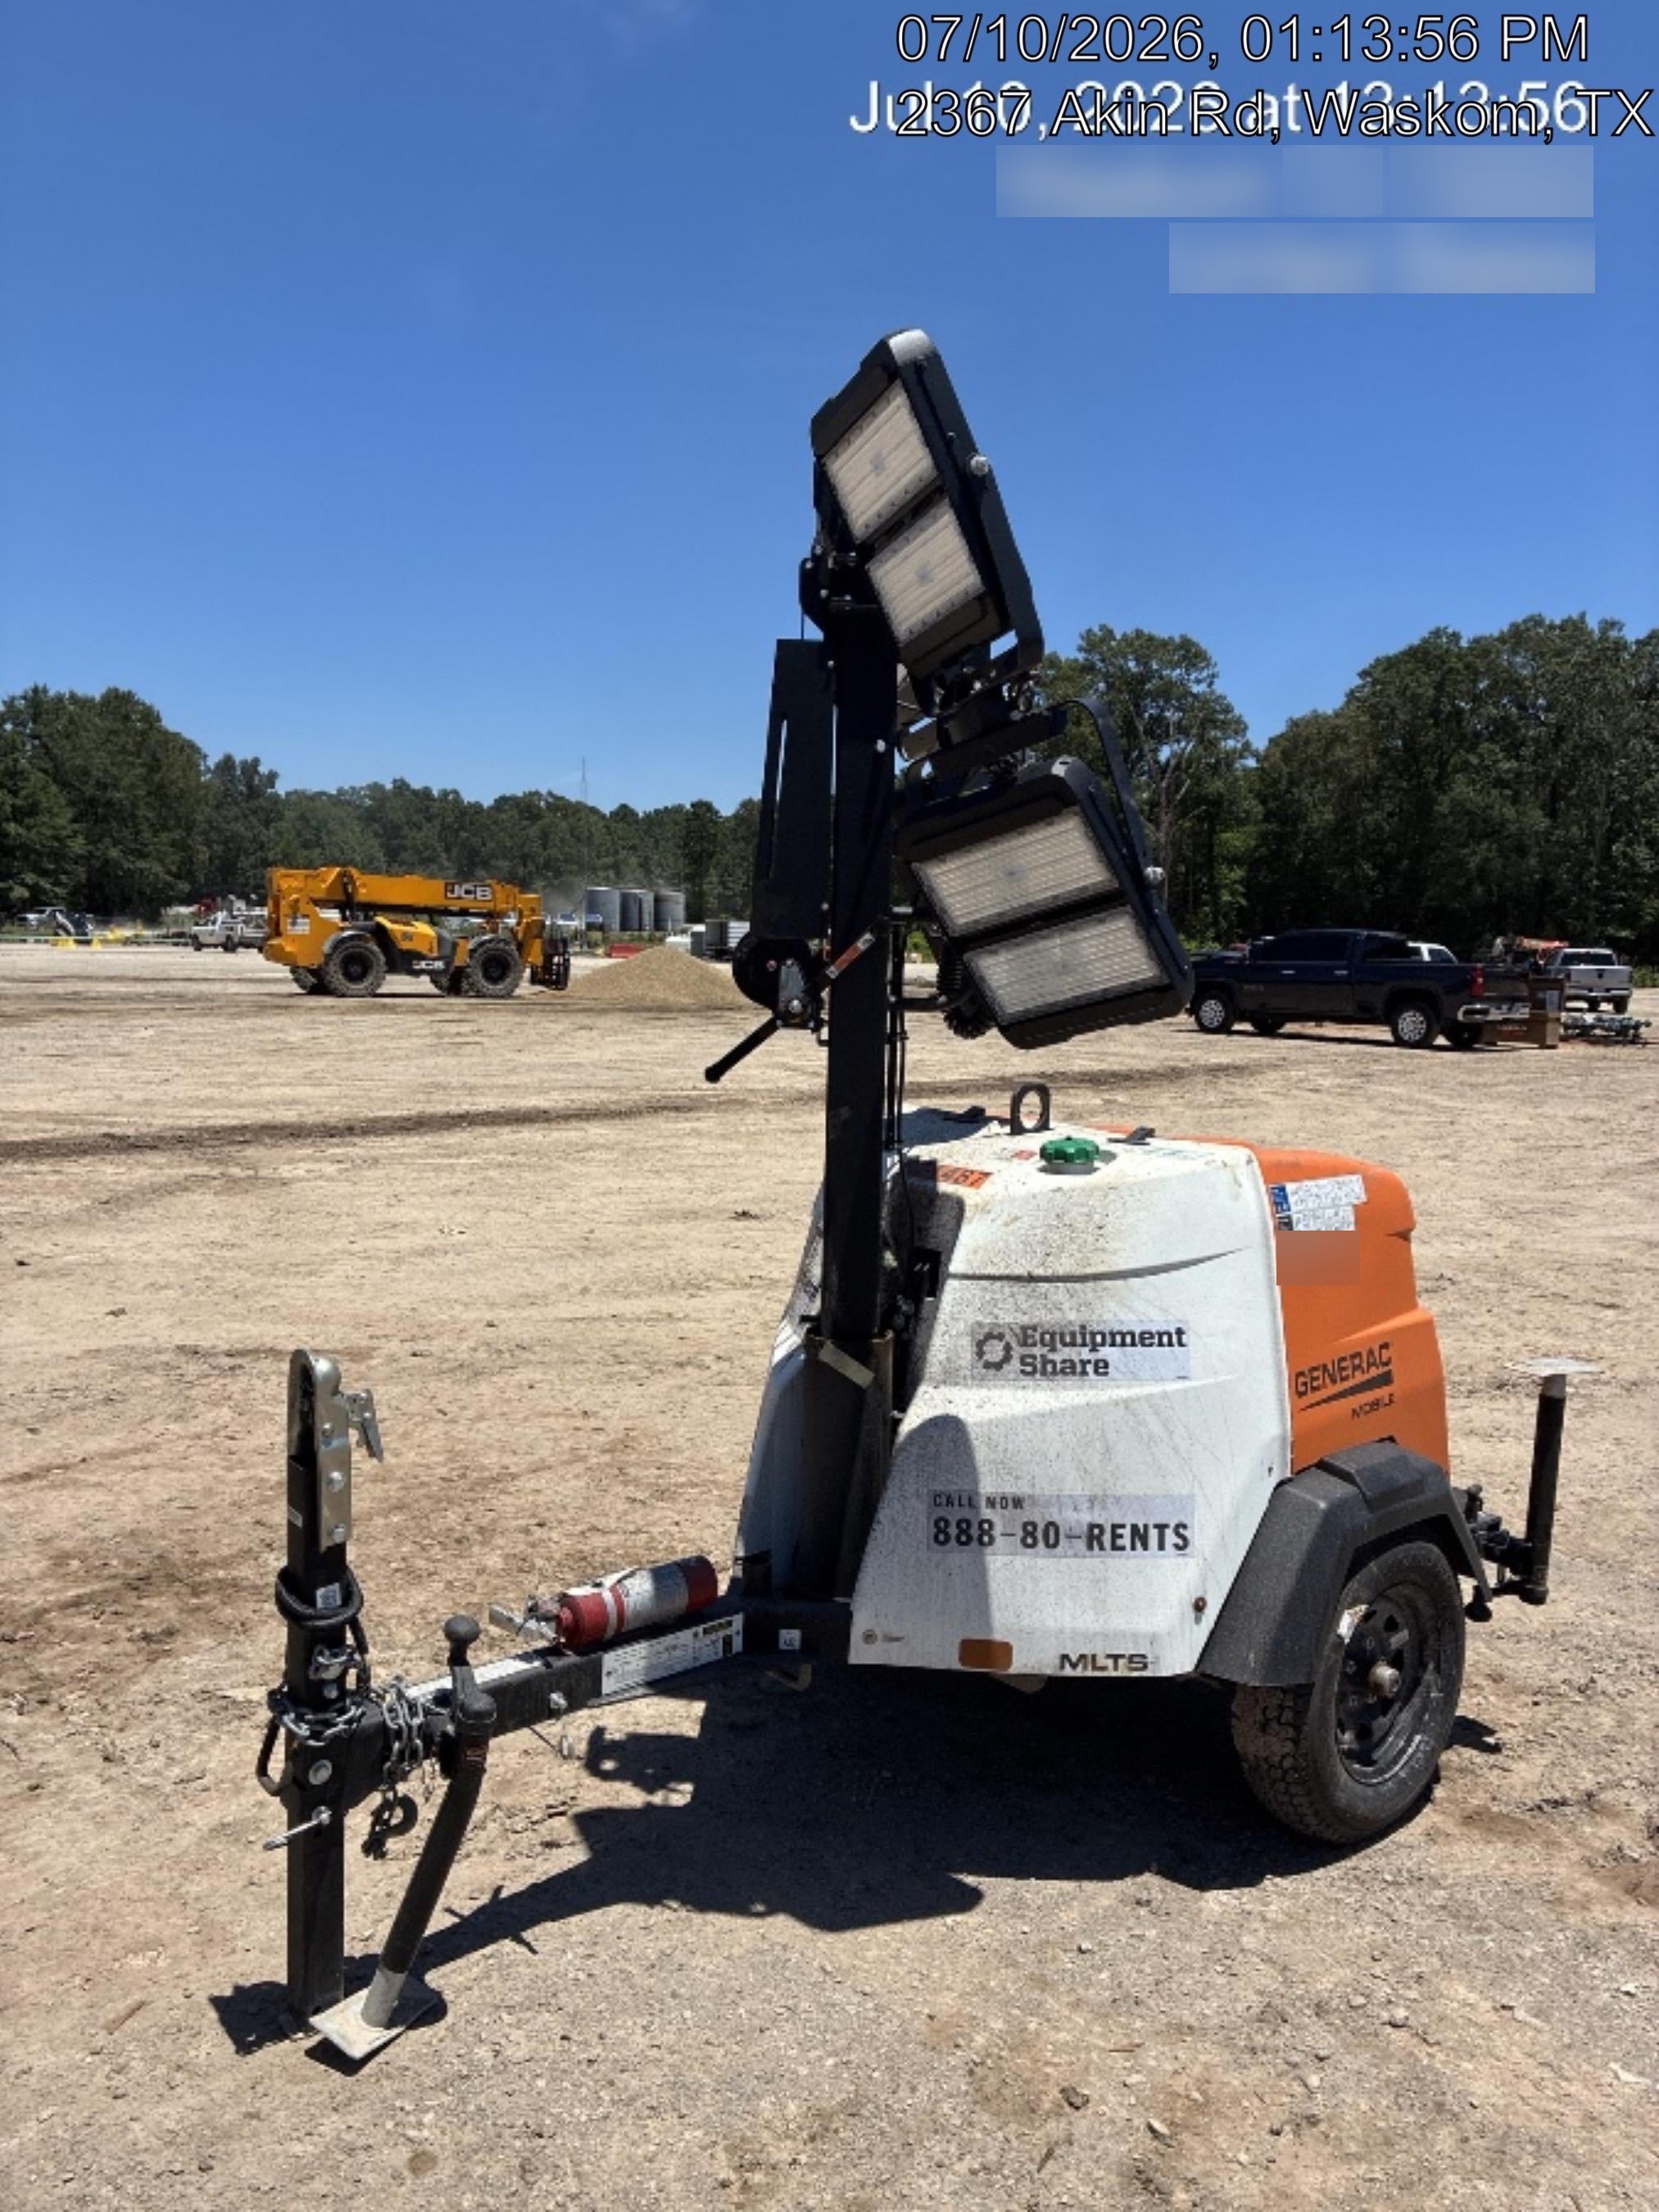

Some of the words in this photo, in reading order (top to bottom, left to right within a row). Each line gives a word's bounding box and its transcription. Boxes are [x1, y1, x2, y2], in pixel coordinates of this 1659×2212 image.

[446, 883, 492, 900] JCB
[1019, 1324, 1187, 1353] Equipment
[1019, 1353, 1110, 1377] Share
[1295, 1341, 1392, 1398] GENERAC
[932, 1494, 977, 1509] CALL
[985, 1495, 1025, 1510] NOW
[932, 1516, 1190, 1552] 888-80-RENTS
[1058, 1652, 1149, 1672] MLTS
